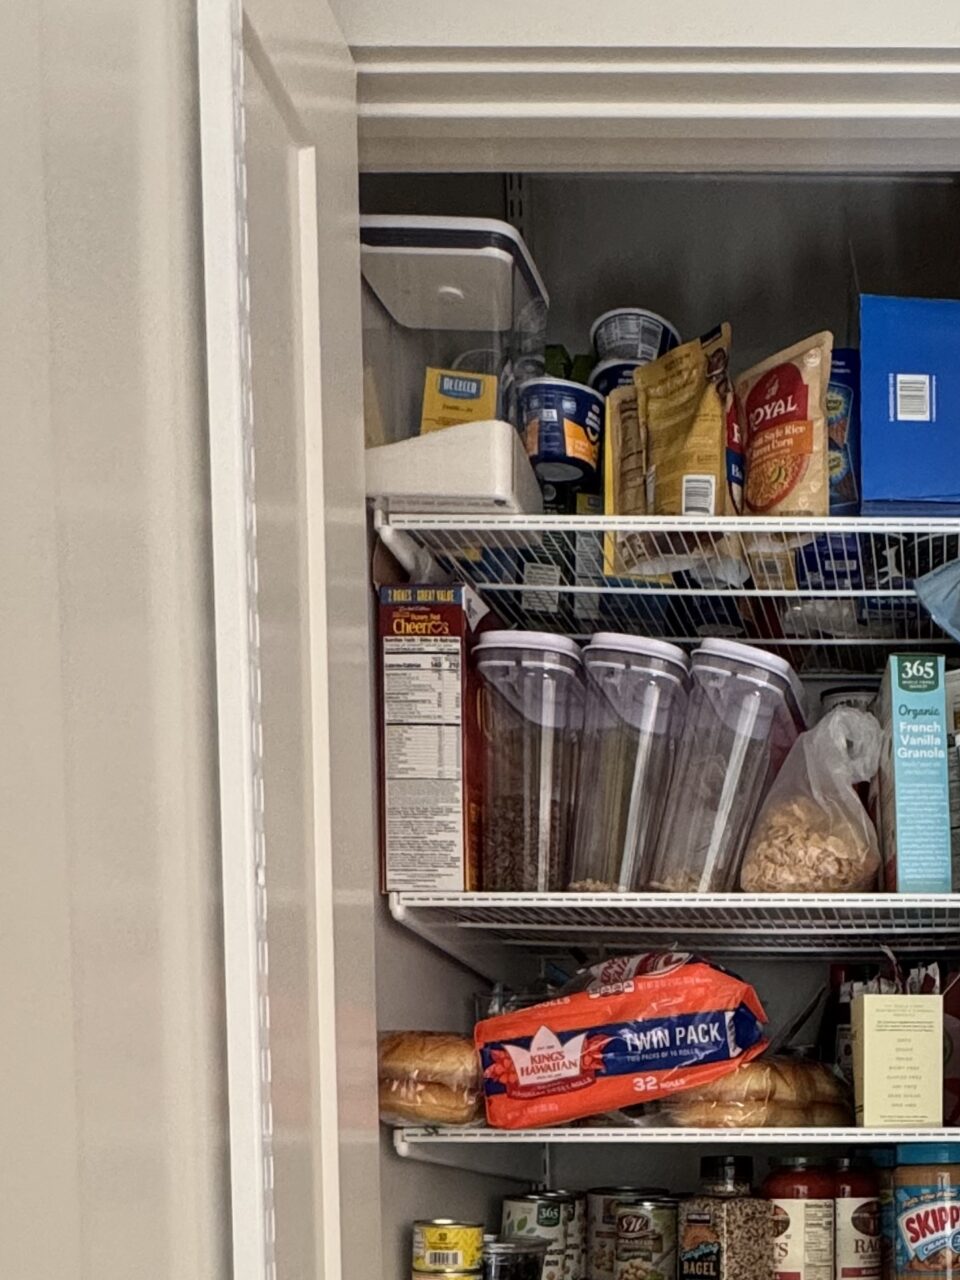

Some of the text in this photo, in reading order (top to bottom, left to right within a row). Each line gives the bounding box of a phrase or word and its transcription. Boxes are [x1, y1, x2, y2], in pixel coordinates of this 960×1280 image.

[901, 660, 935, 679] 365
[898, 704, 941, 720] Organic
[899, 721, 941, 733] French
[900, 734, 941, 745] Vanilla
[897, 747, 945, 758] Granola
[623, 1022, 721, 1051] TWIN PACK
[530, 1051, 565, 1065] KING'S
[520, 1059, 578, 1077] HAWAIIAN
[633, 1076, 659, 1092] 32
[539, 1207, 560, 1219] 365
[683, 1261, 716, 1276] BAGEL
